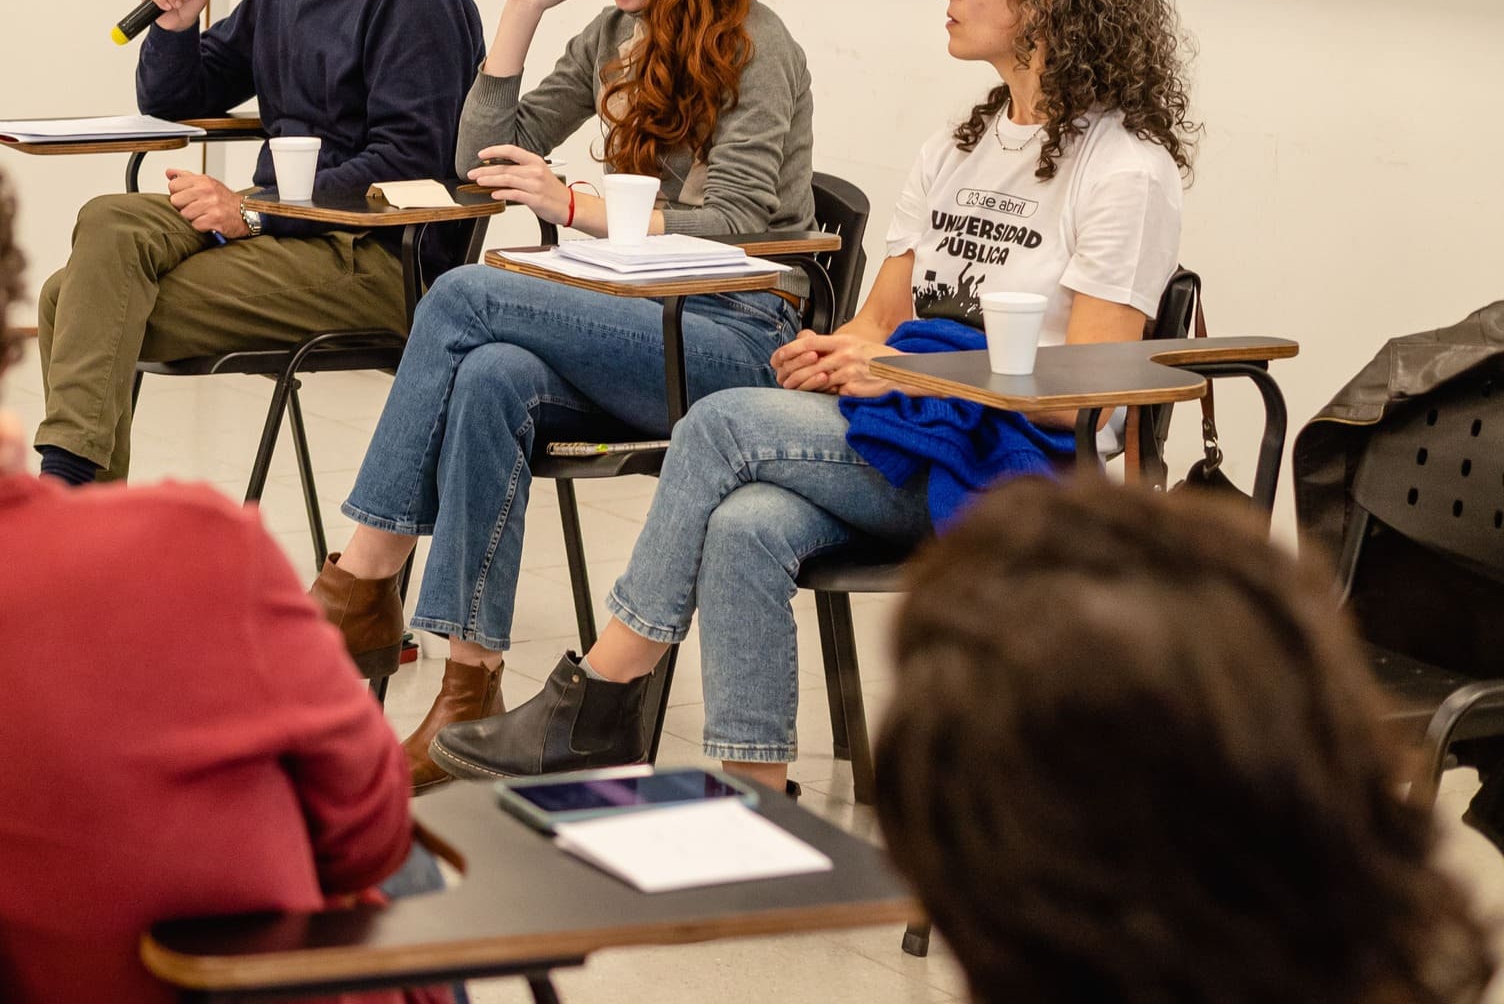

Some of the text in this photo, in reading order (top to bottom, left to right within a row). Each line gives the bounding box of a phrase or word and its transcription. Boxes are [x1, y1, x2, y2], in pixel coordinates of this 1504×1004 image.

[966, 191, 980, 206] 23
[998, 198, 1026, 215] abril
[935, 231, 1010, 266] PÚBLICA
